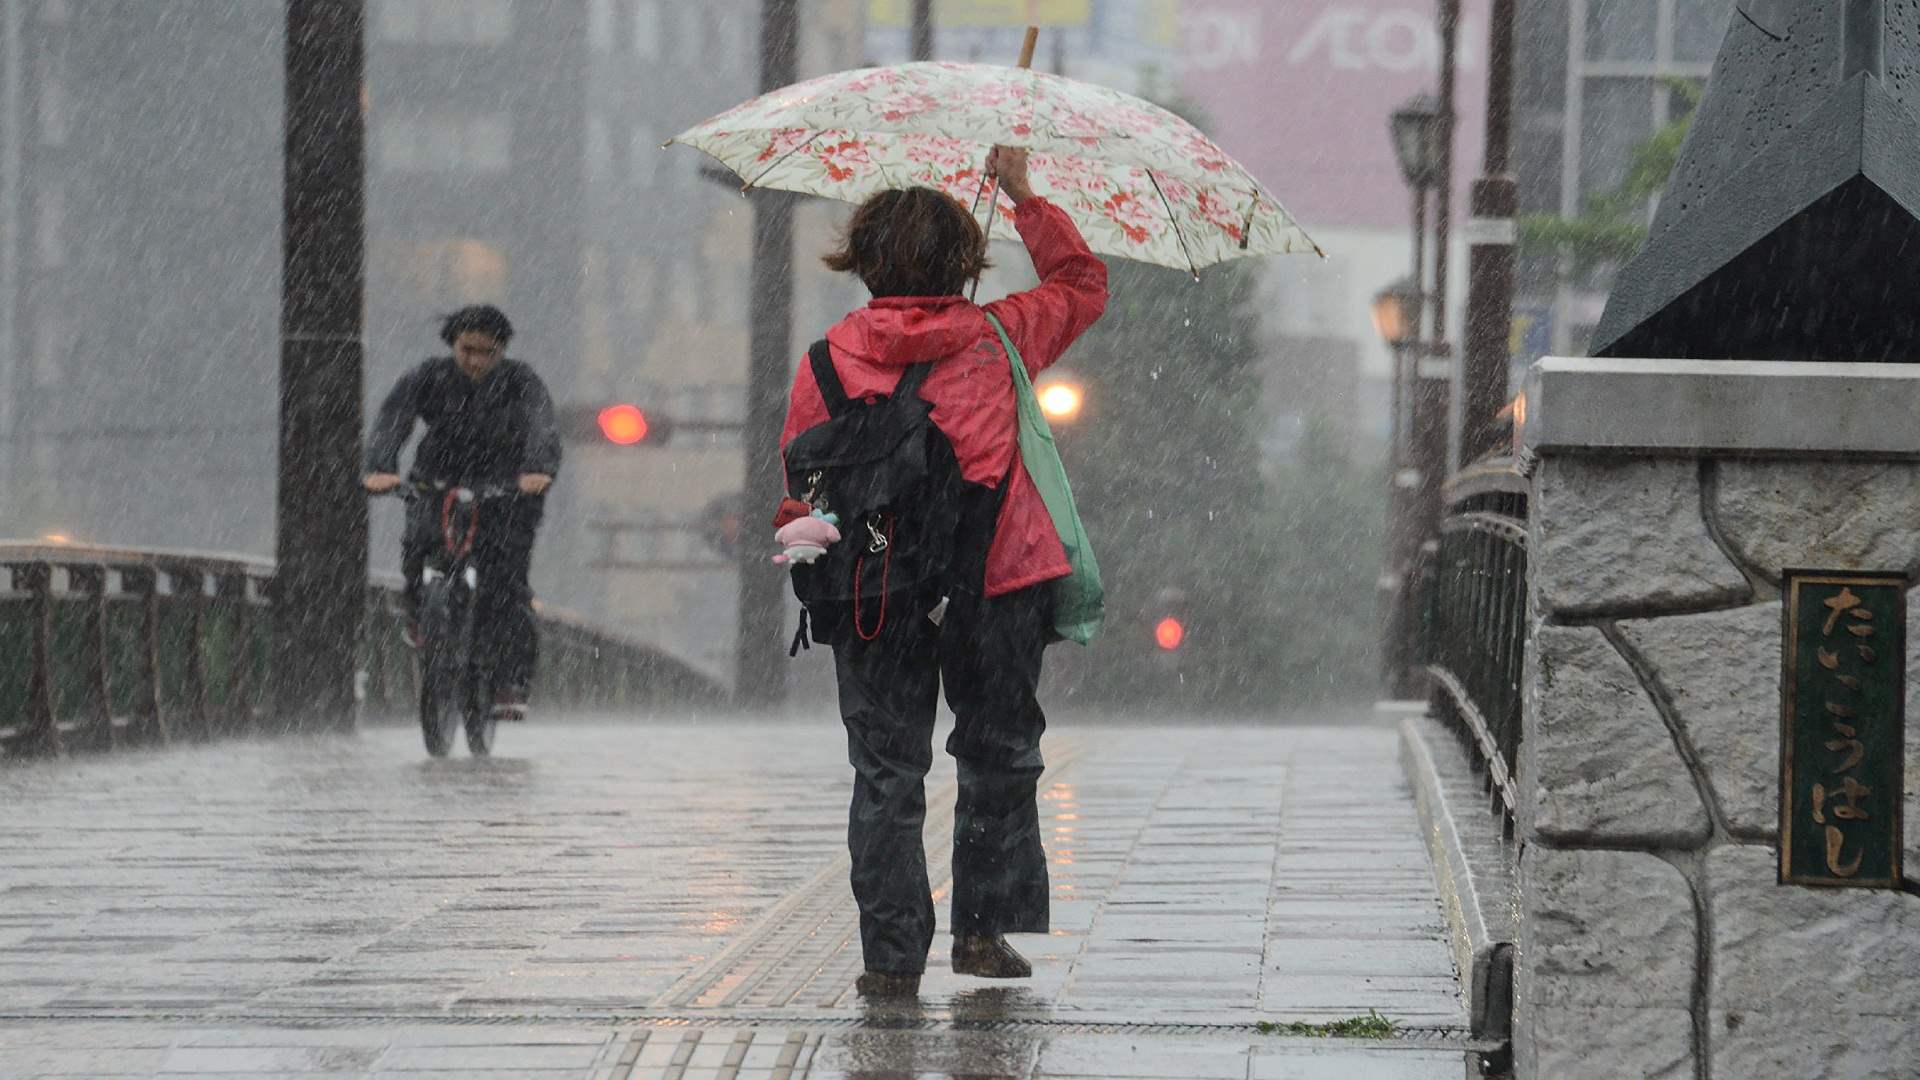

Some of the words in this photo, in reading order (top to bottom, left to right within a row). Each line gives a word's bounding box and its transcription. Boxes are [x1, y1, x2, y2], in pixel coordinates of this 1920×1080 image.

[1812, 586, 1875, 877] たいこうはし
